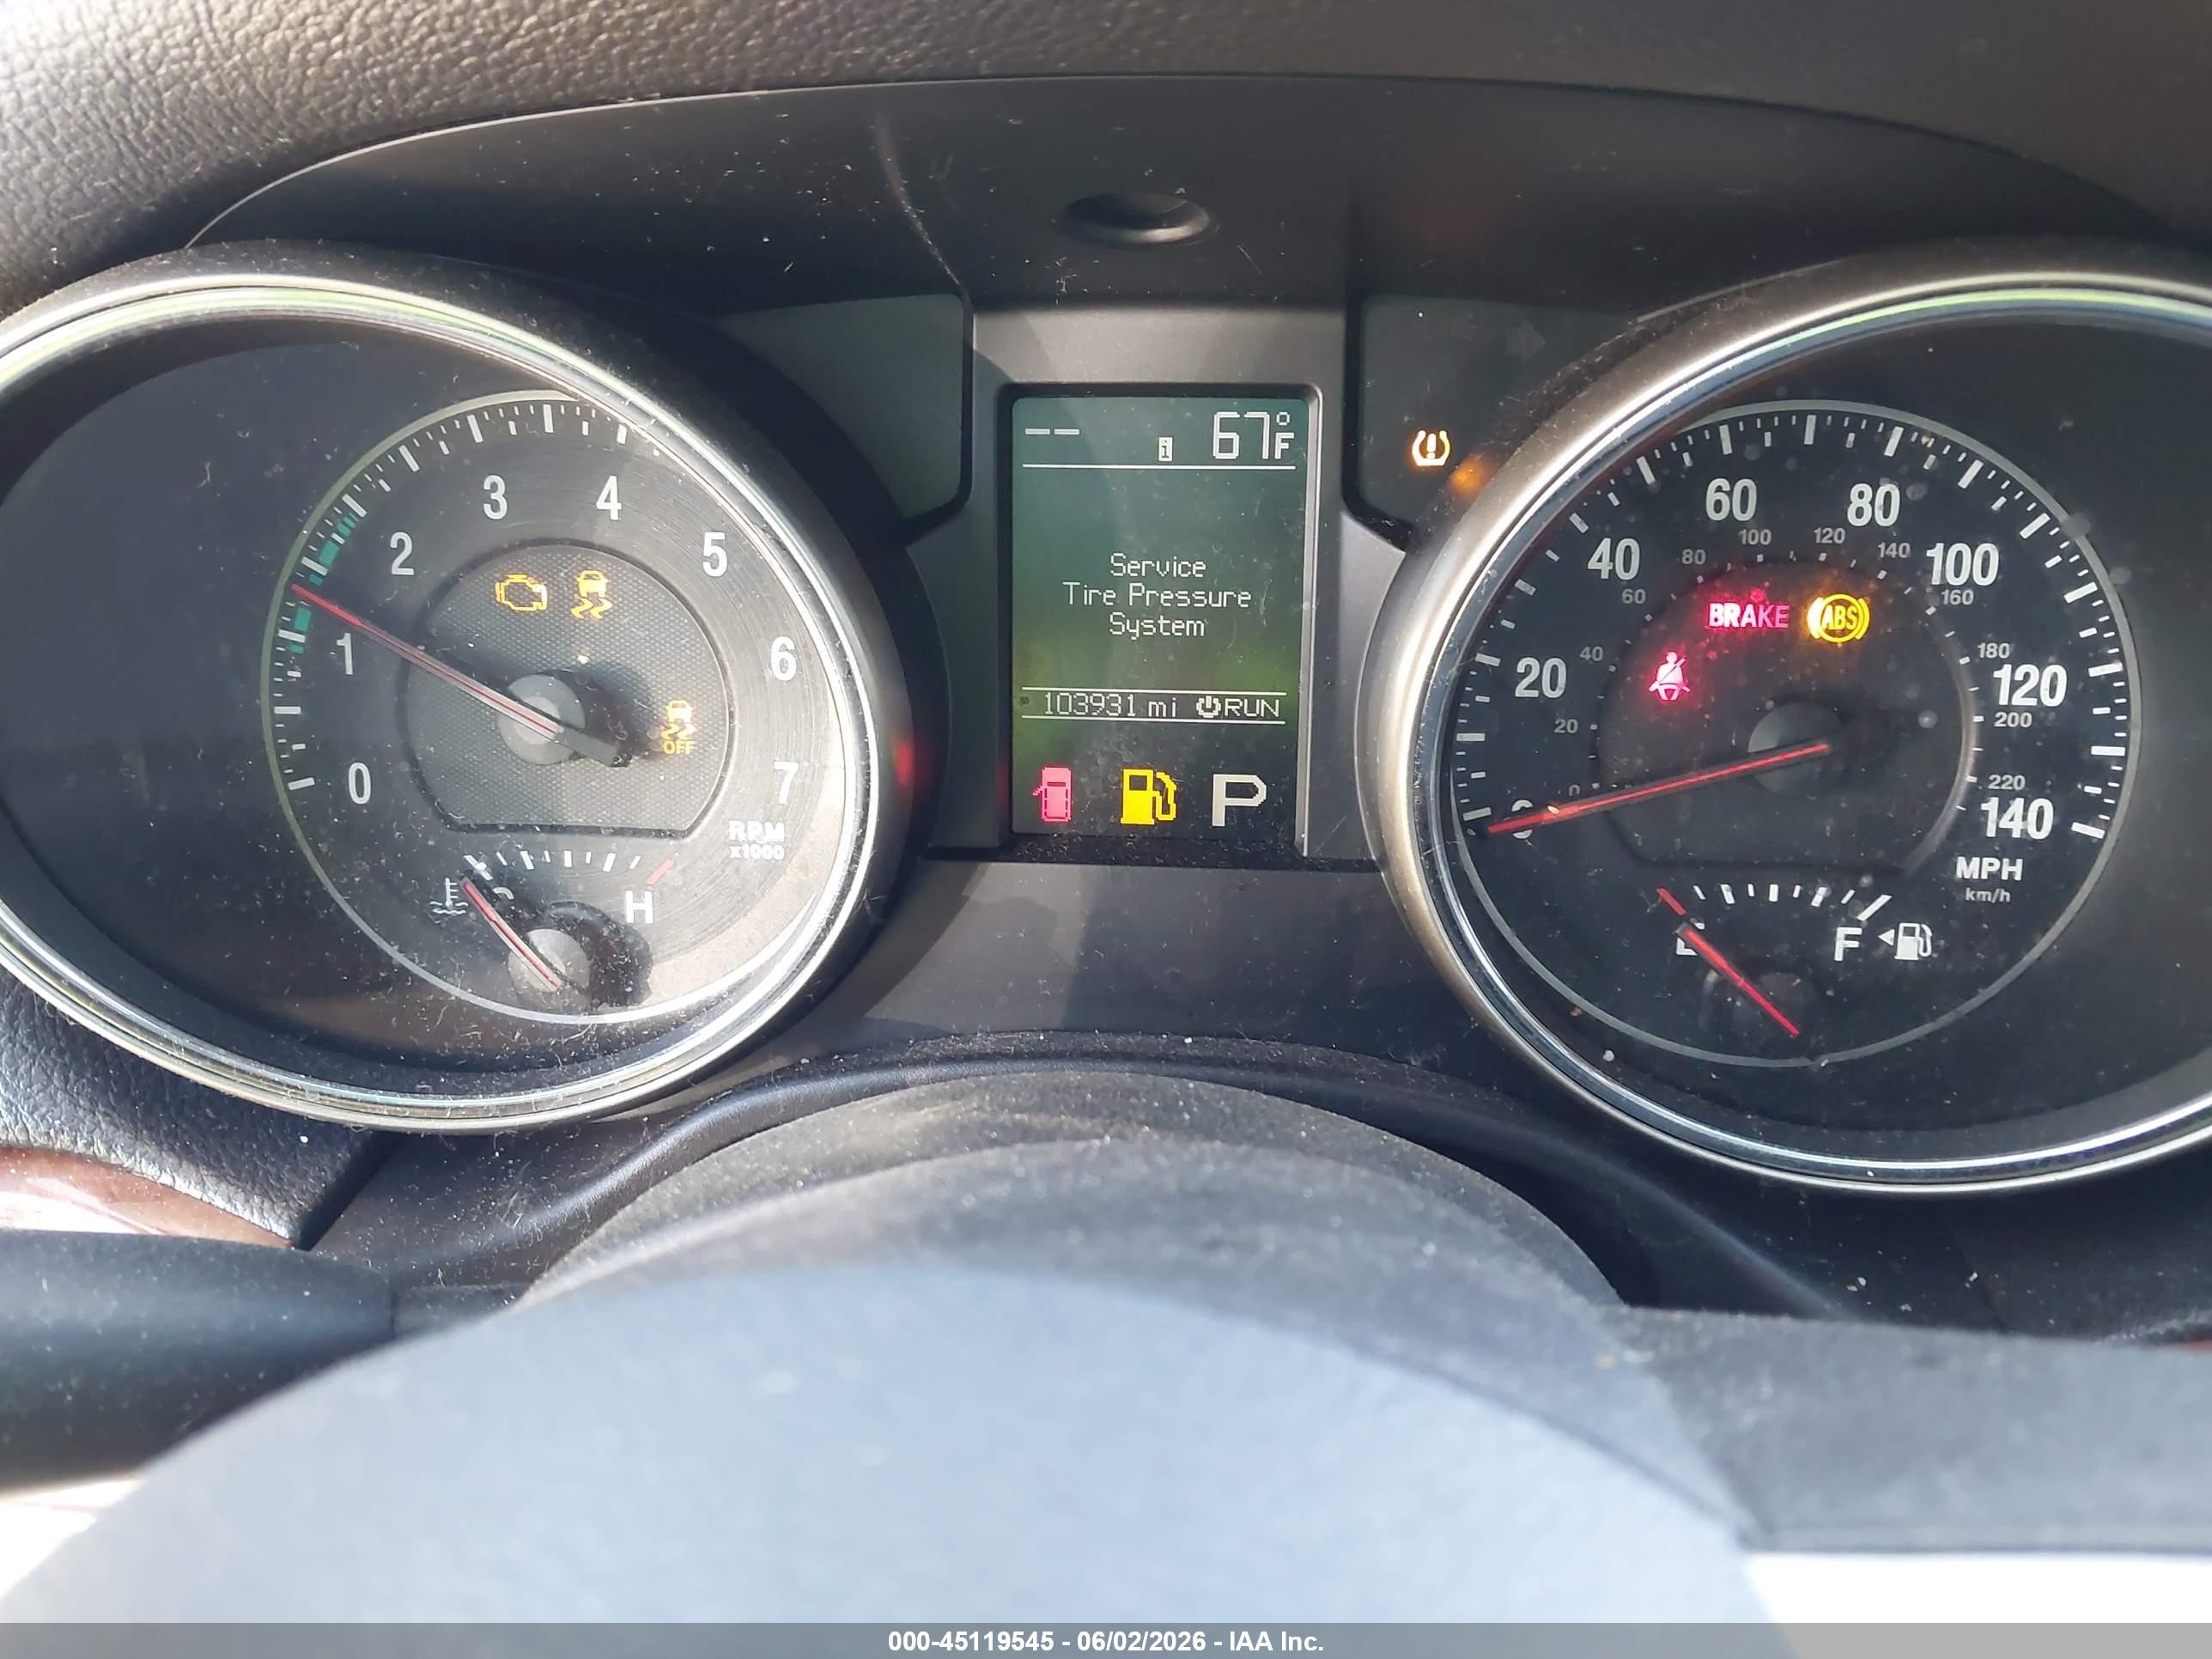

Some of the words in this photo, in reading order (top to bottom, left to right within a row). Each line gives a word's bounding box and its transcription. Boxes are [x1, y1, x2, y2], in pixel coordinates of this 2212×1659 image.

[483, 475, 507, 520] 3
[596, 476, 622, 520] 4
[1705, 478, 1757, 521] 60
[1847, 484, 1900, 526] 80
[1738, 529, 1771, 545] 100
[1814, 528, 1845, 544] 120
[390, 532, 414, 575] 2
[702, 532, 727, 576] 5
[1588, 538, 1639, 580] 40
[1682, 550, 1705, 566] 80
[1877, 543, 1911, 558] 140
[1110, 553, 1206, 578] Service
[1926, 543, 1999, 586] 100
[1063, 582, 1115, 606] Tire
[1128, 584, 1251, 608] Pressure
[1622, 588, 1646, 605] 60
[1942, 590, 1974, 605] 160
[1109, 612, 1205, 640] System
[1708, 604, 1789, 629] BRAKE
[1822, 605, 1858, 630] ABS
[337, 632, 354, 675] 1
[770, 637, 796, 680] 6
[1580, 647, 1604, 662] 40
[1978, 643, 2009, 659] 180
[1516, 658, 1566, 698] 20
[1993, 665, 2068, 707] 120
[1044, 693, 1136, 716] 103931
[1149, 698, 1176, 718] mi
[1224, 698, 1279, 717] RUN
[1554, 719, 1578, 734] 20
[1995, 713, 2032, 728] 200
[663, 740, 695, 755] OFF
[348, 763, 371, 804] 0
[774, 762, 799, 804] 7
[1989, 775, 2025, 790] 220
[1212, 774, 1267, 827] P
[1981, 796, 2054, 839] 140
[728, 821, 785, 842] RPM
[729, 844, 785, 860] x1000
[1955, 856, 2024, 880] MPH
[626, 891, 653, 923] H
[1966, 888, 2010, 904] km/h
[1833, 927, 1862, 961] F
